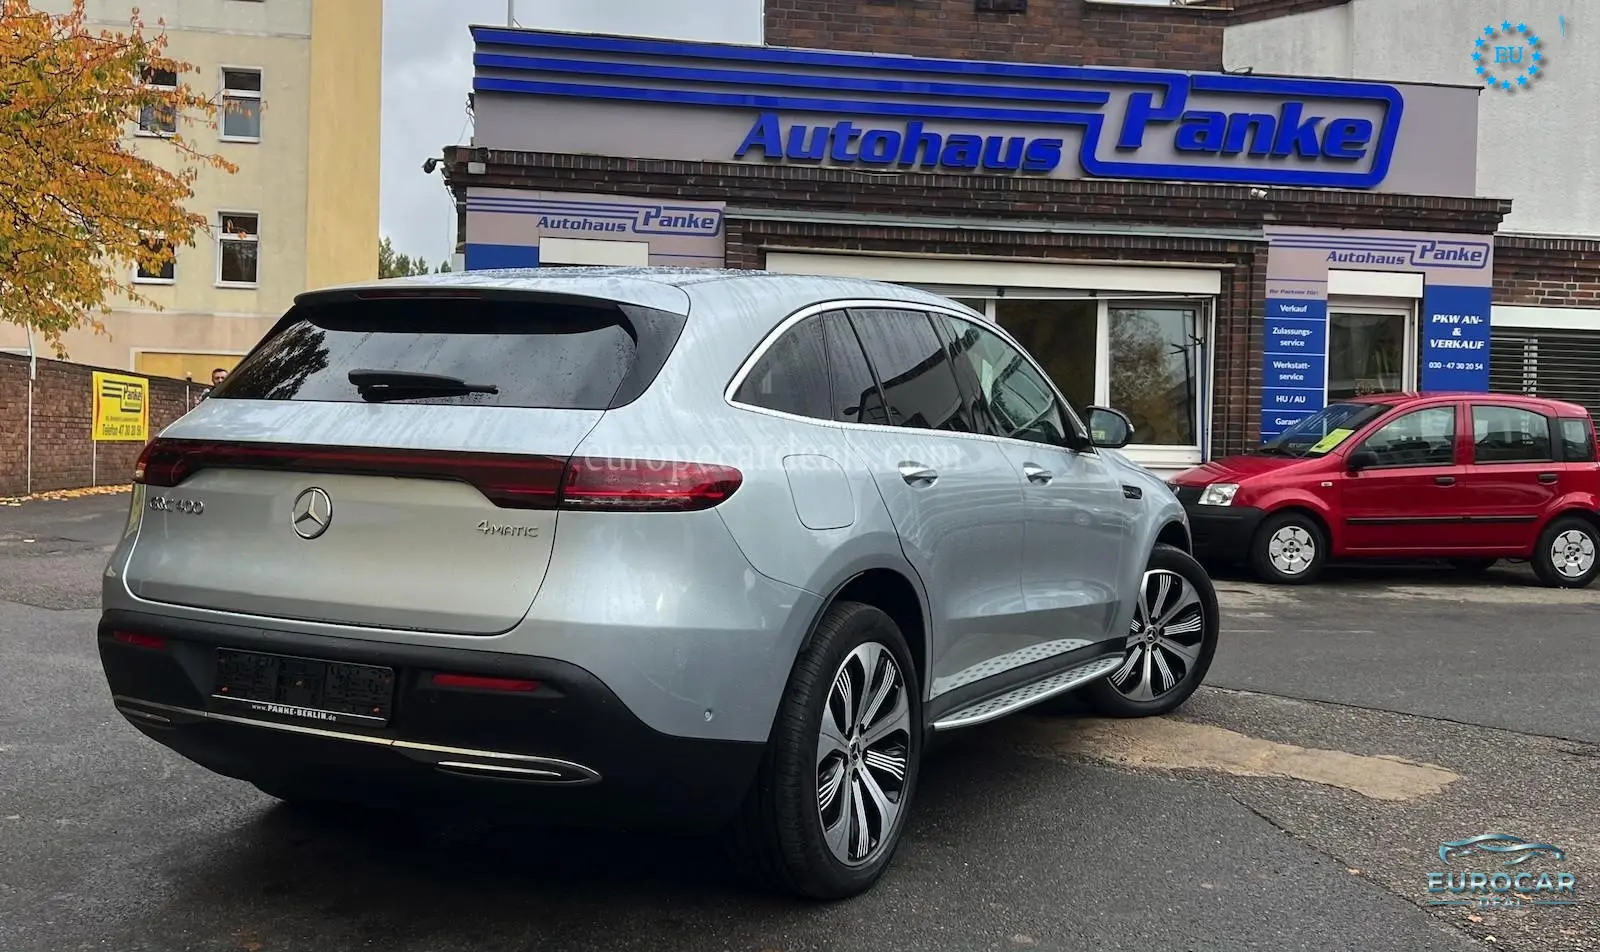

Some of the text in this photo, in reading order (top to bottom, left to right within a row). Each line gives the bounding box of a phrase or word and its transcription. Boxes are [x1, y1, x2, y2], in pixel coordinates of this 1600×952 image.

[733, 77, 1371, 173] Autohaus Panke
[536, 206, 715, 232] Autohaus Panke
[1326, 241, 1483, 265] Autohaus Panke
[1280, 305, 1308, 313] Verkauf
[1432, 314, 1484, 324] PKW AN-
[1272, 327, 1313, 336] Zulassungs-
[1452, 327, 1462, 336] &
[1280, 339, 1305, 347] service
[1430, 339, 1485, 350] VERKAUF
[1273, 361, 1311, 370] Werkstatt-
[1428, 361, 1442, 369] 030
[1456, 362, 1465, 370] 30
[1279, 373, 1304, 381] service
[1276, 395, 1288, 403] HU
[176, 499, 205, 515] 400
[476, 519, 539, 538] 4MATIC
